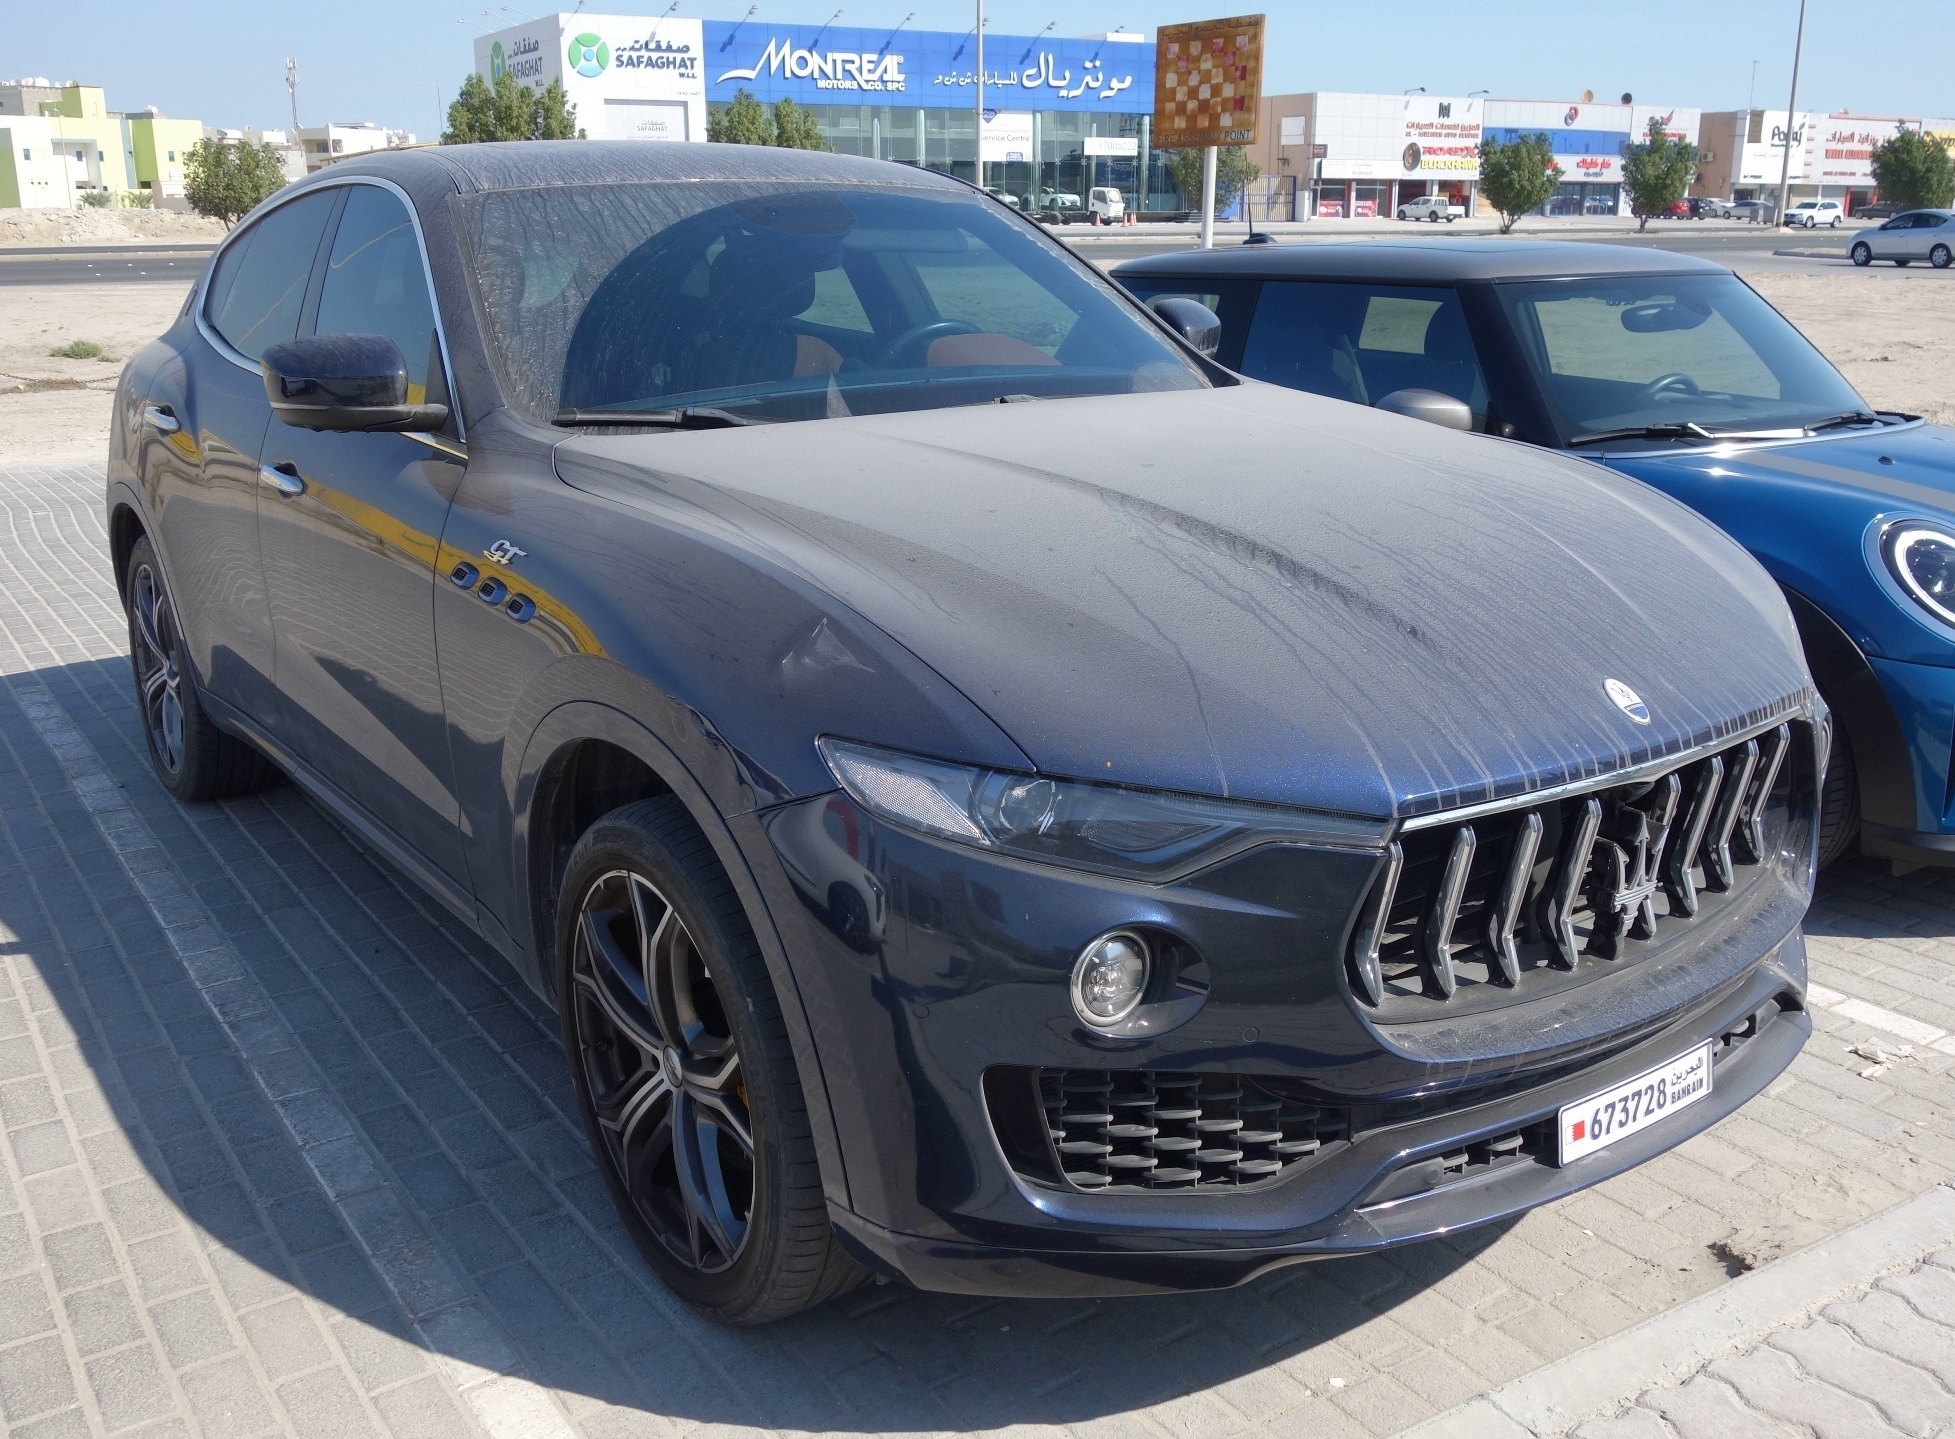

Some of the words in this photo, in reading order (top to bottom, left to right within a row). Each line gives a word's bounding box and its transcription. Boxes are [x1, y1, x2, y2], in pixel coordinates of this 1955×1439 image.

[630, 40, 690, 54] صفقات
[508, 57, 543, 80] SAFAGHAT
[615, 54, 698, 71] SAFAGHAT
[716, 37, 906, 90] MONTREAL
[1021, 51, 1133, 99] مونتريال
[817, 80, 858, 90] MOTORS
[868, 81, 885, 91] CO.
[886, 81, 906, 91] SPC
[1007, 134, 1030, 142] Centre
[1158, 133, 1175, 144] FIRE
[1177, 131, 1222, 143] ASSEMBLY
[1224, 129, 1251, 141] POINT
[1420, 160, 1478, 170] BLACKHAWK
[1670, 1056, 1704, 1086] البحرين
[1590, 1077, 1667, 1141] 673728
[1670, 1076, 1704, 1105] BAHRAIN
